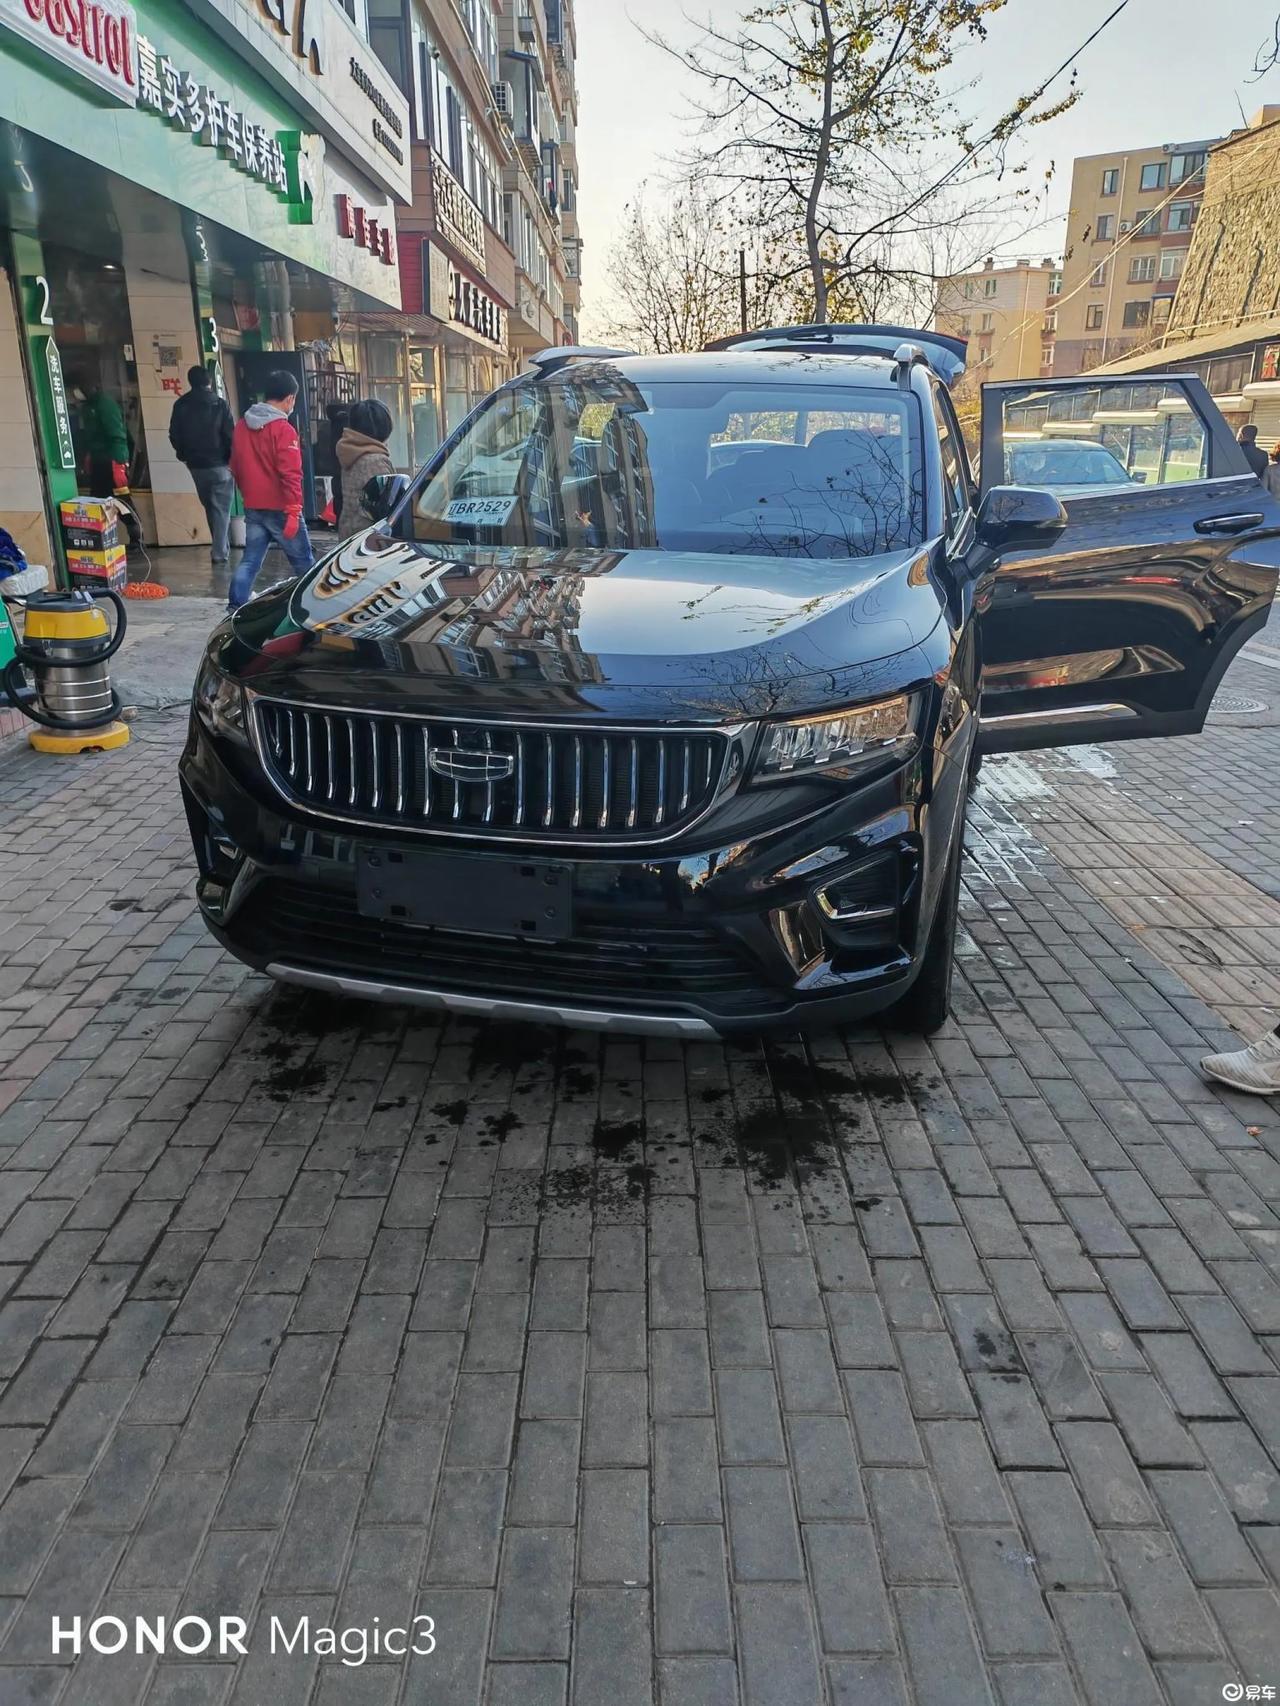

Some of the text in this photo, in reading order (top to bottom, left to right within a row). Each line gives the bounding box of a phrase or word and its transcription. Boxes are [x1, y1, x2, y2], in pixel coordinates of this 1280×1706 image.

[136, 33, 289, 195] 嘉实多护车保养站
[36, 275, 54, 326] 2
[209, 317, 219, 353] 3
